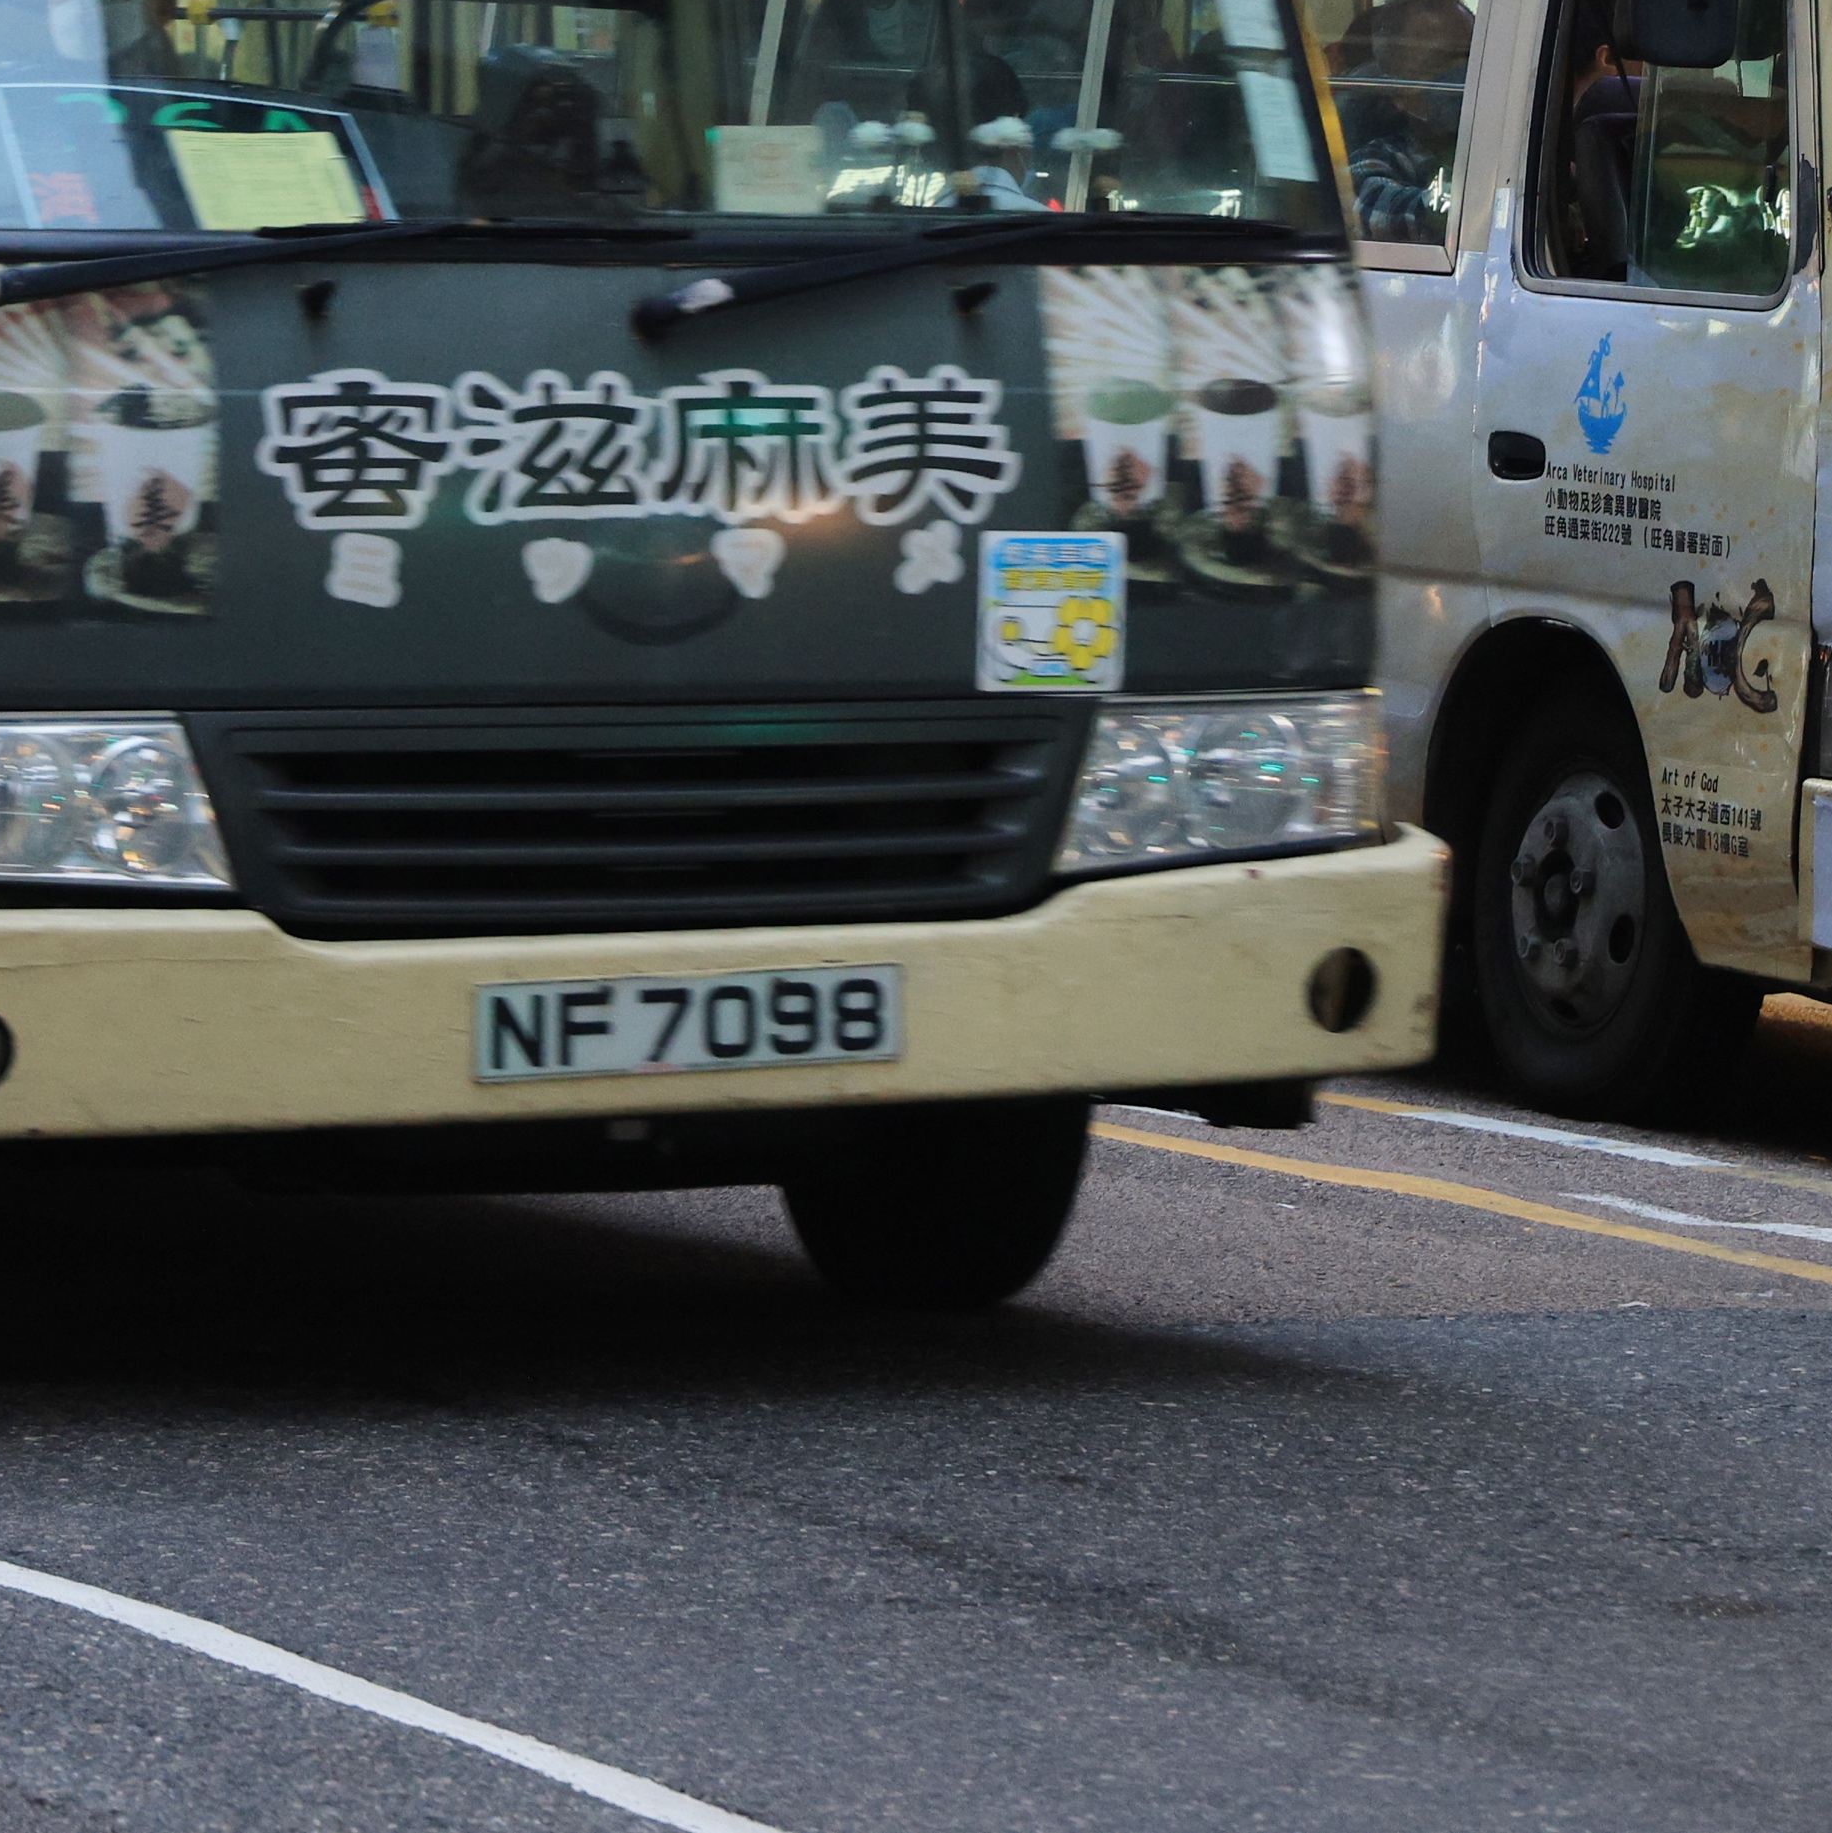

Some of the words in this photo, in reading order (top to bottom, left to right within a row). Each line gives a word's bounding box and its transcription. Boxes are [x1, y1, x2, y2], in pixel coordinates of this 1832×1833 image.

[1545, 461, 1568, 481] Arca
[1572, 464, 1626, 490] Veterinary
[1631, 470, 1676, 493] Hospital
[1545, 486, 1662, 522] 小動物及珍禽異獸醫院
[1544, 515, 1632, 547] 旺角通菜街222號
[1643, 526, 1731, 559] (旺角警署對面)
[1661, 766, 1679, 786] Art
[1684, 772, 1696, 789] of
[1700, 772, 1719, 793] God
[1661, 793, 1762, 832] 太子太子道西141號
[487, 986, 614, 1071] NF
[638, 977, 886, 1067] 7098
